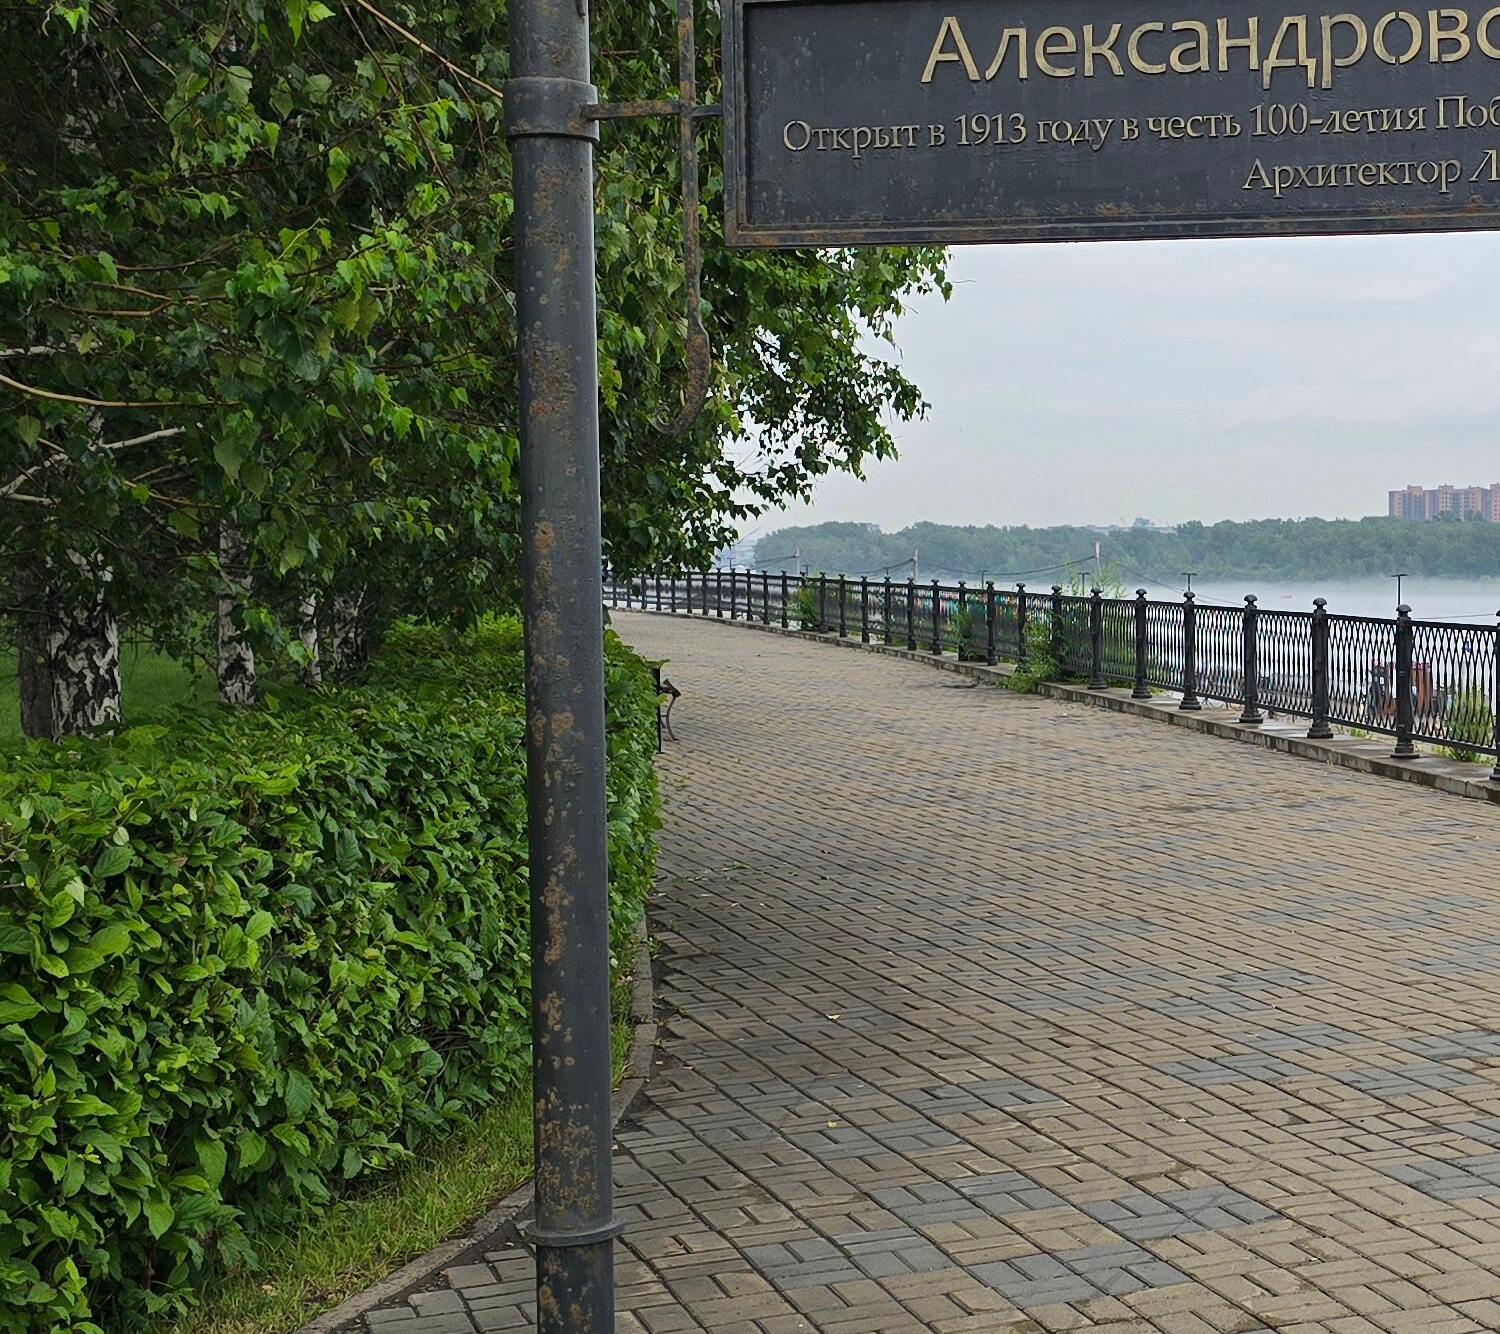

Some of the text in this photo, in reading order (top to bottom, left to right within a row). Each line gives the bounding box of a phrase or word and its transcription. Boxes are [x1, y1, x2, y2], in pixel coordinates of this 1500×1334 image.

[783, 120, 920, 159] Открыт
[927, 124, 946, 147] в
[954, 112, 1028, 146] 1913
[1036, 118, 1115, 151] году
[1120, 118, 1140, 141] в
[1146, 114, 1242, 139] честь
[1250, 102, 1426, 136] 100-летия
[1241, 158, 1461, 199] Архитектор
